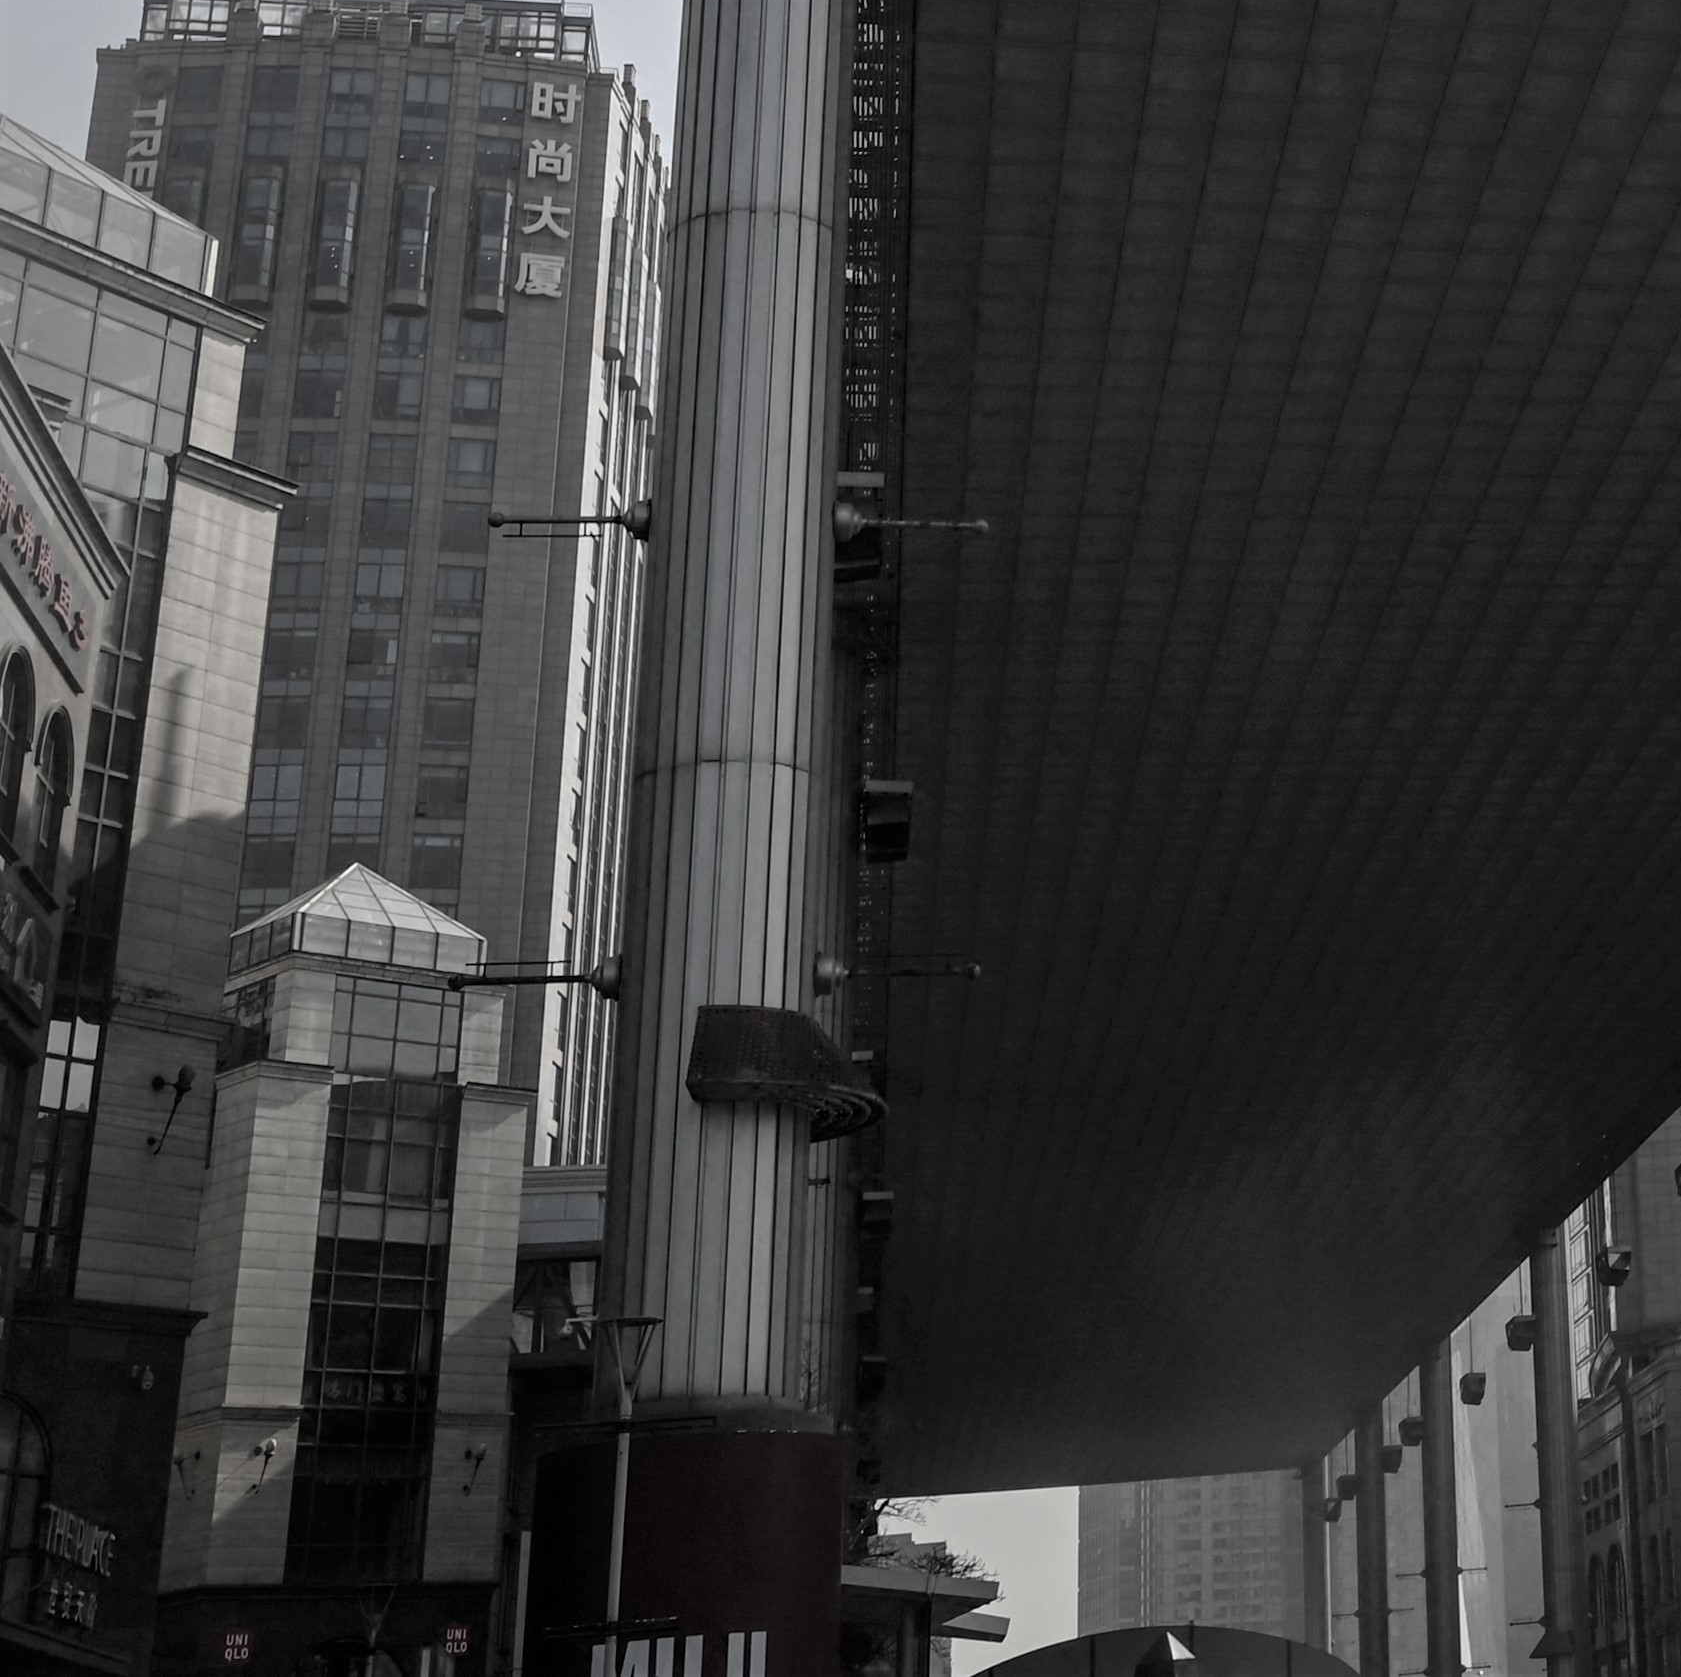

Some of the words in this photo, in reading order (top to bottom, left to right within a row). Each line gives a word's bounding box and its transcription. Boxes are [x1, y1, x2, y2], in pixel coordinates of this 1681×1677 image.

[123, 99, 166, 199] TRE
[514, 81, 581, 299] 时尚大厦
[225, 1633, 250, 1647] UNI
[446, 1628, 468, 1642] UNI
[224, 1647, 250, 1662] QLO
[445, 1642, 469, 1655] QLO
